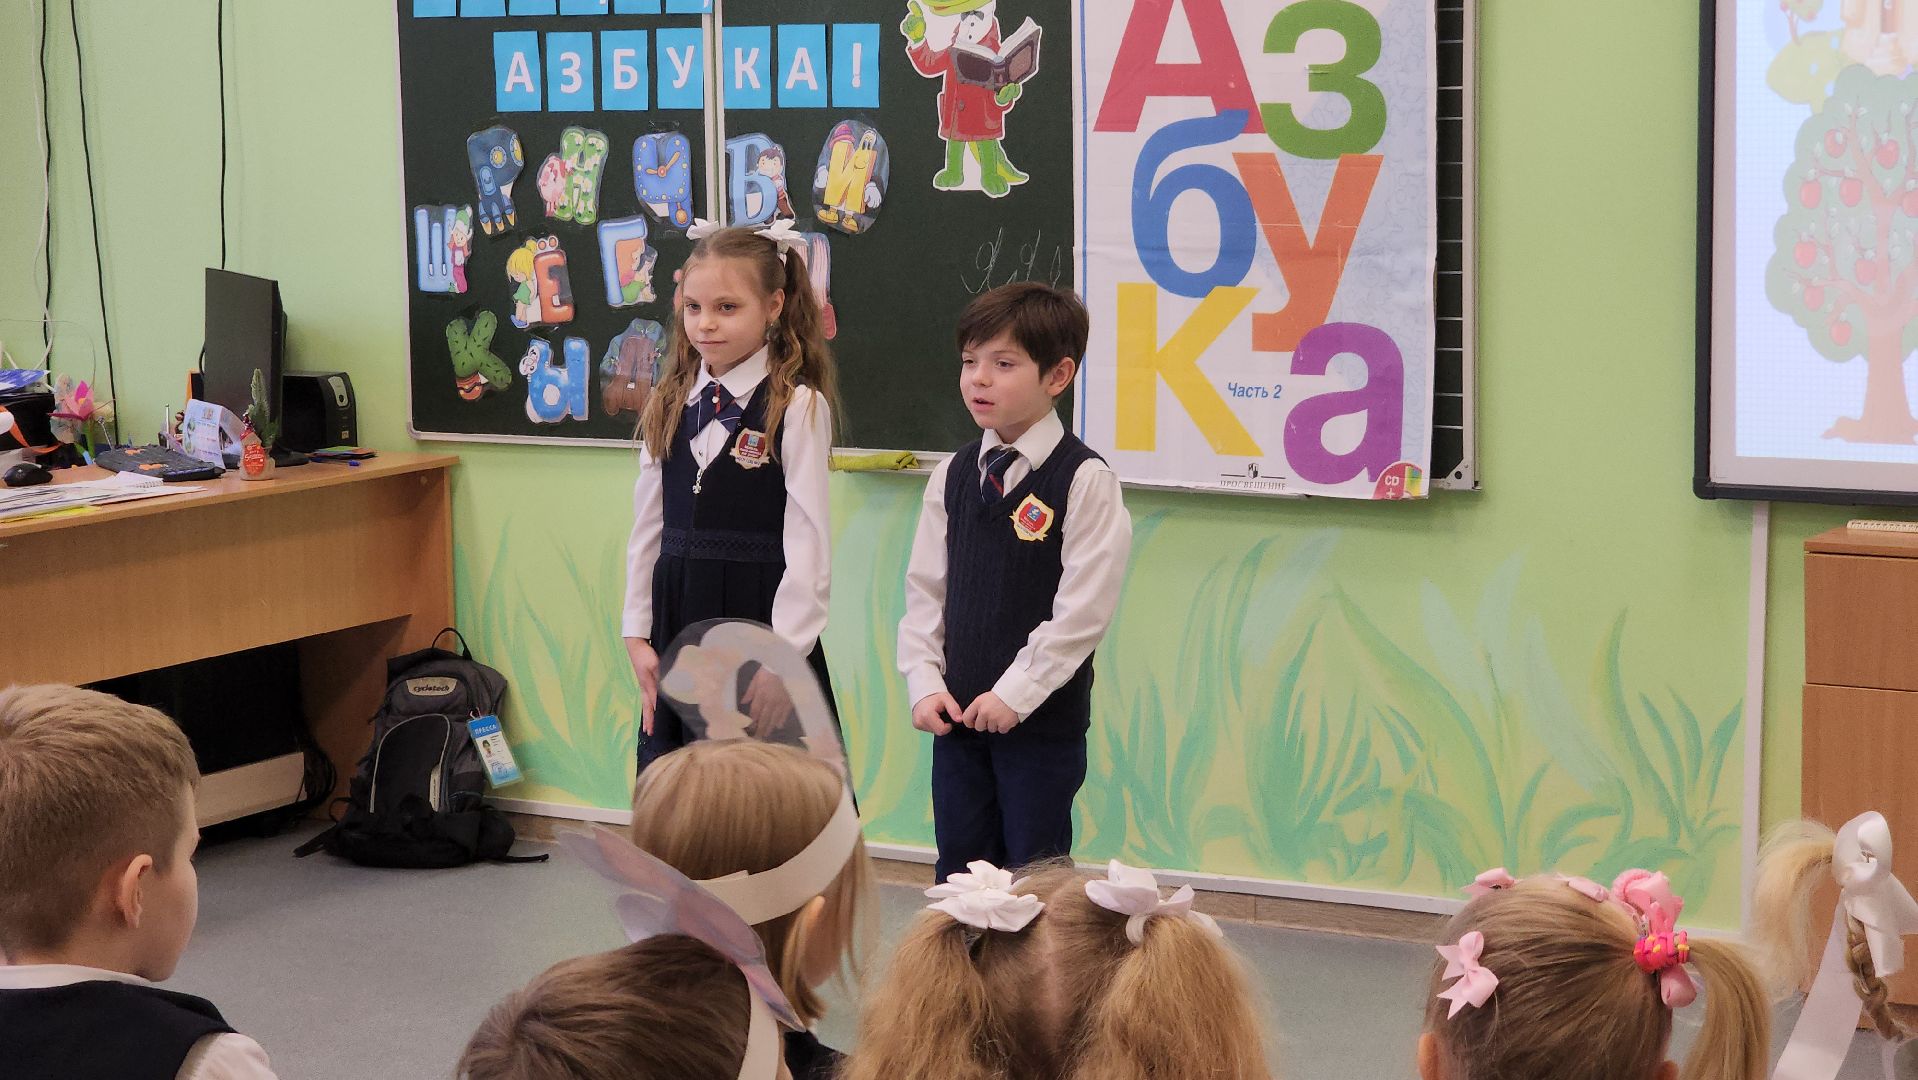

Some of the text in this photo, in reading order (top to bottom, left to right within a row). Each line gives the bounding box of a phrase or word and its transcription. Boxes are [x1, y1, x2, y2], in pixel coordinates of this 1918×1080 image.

[504, 42, 862, 93] АЗБУКА!
[1227, 382, 1282, 399] Часть 2
[1385, 475, 1399, 486] CD
[474, 724, 497, 735] ПРЕССА
